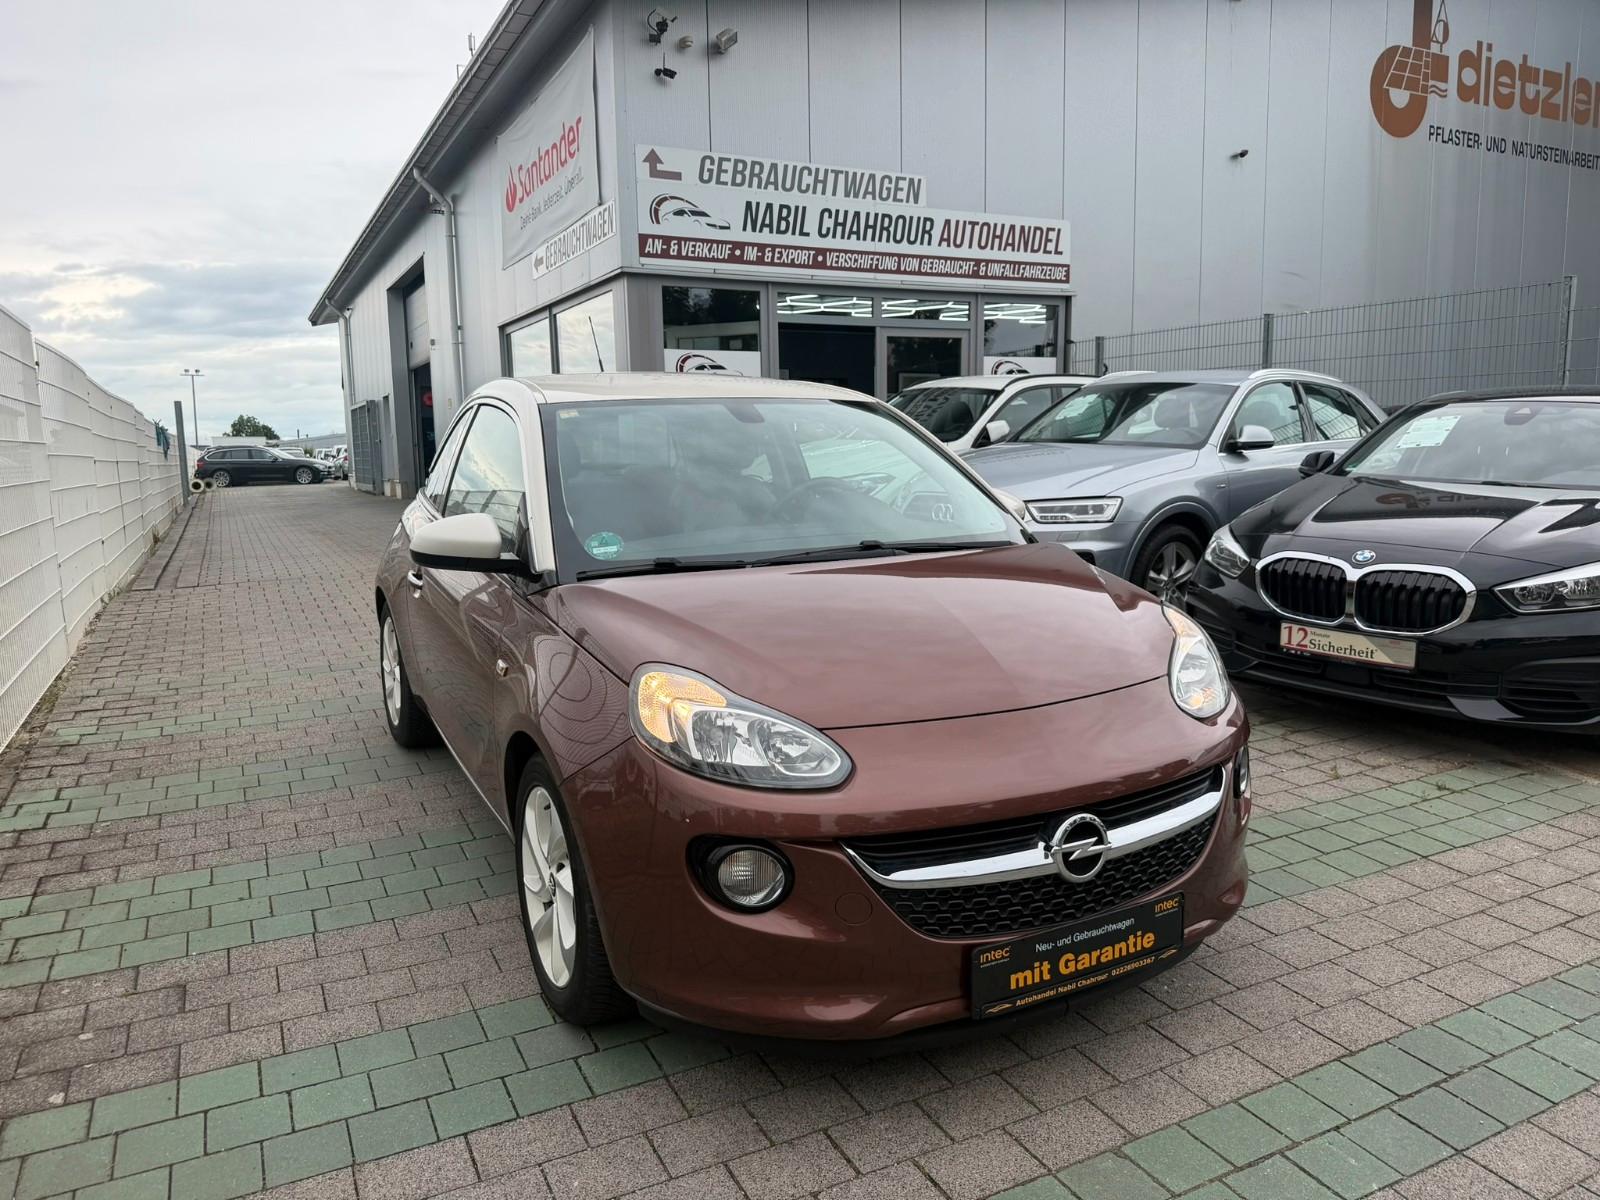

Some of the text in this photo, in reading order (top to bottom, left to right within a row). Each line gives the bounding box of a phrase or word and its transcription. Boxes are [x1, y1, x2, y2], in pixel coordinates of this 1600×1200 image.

[1428, 125, 1483, 150] PFLASTER-
[1485, 135, 1507, 154] UND
[518, 116, 582, 205] Santander
[698, 155, 922, 205] GEBRAUCHTWAGEN
[545, 202, 614, 271] GEBRAUCHTWAGEN
[742, 200, 1064, 256] NABIL CHAHROUR AUTOHANDEL
[645, 238, 1067, 281] AN- & VERKAUF IM- & EXPORT VERSCHIFFUNG VON GEBRAUCHT- & UNFALLFAHRZEUGE
[1283, 626, 1308, 649] 12
[1309, 638, 1375, 659] Sicherheit
[1155, 897, 1179, 912] intec
[1035, 917, 1135, 953] Neu- und Gebrauchtwagen
[980, 947, 1010, 964] intec
[1010, 931, 1155, 990] mit Garantie
[1016, 988, 1056, 1006] Autohandel
[1058, 981, 1076, 993] Nabil
